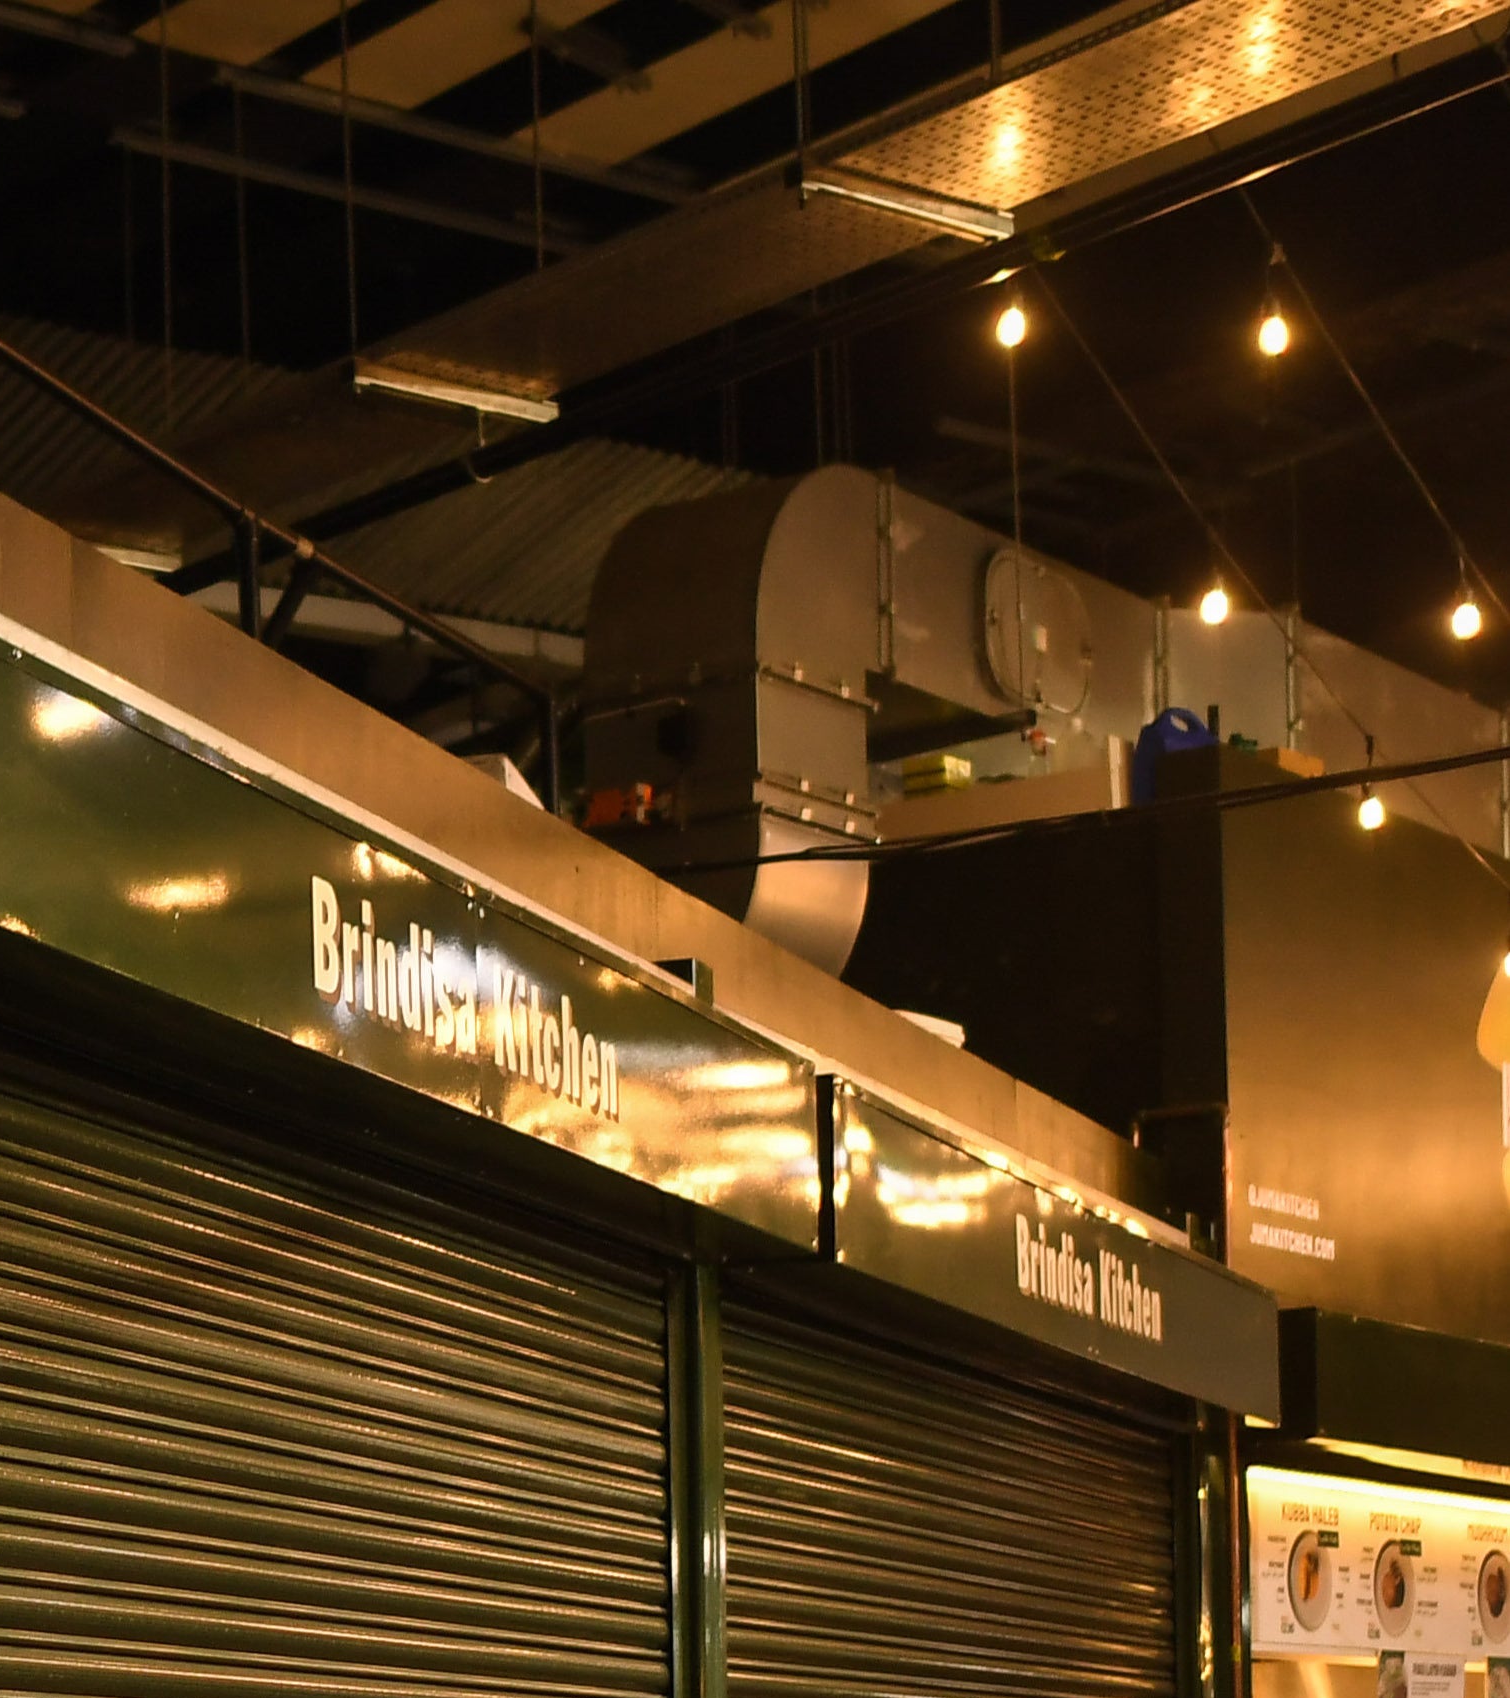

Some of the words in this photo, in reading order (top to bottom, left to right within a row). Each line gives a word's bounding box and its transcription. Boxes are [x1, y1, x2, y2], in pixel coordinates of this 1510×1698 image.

[311, 874, 477, 1056] Brindisa
[491, 962, 620, 1116] Kitchen
[1015, 1212, 1094, 1317] Brindisa
[1099, 1249, 1163, 1342] Kitchen
